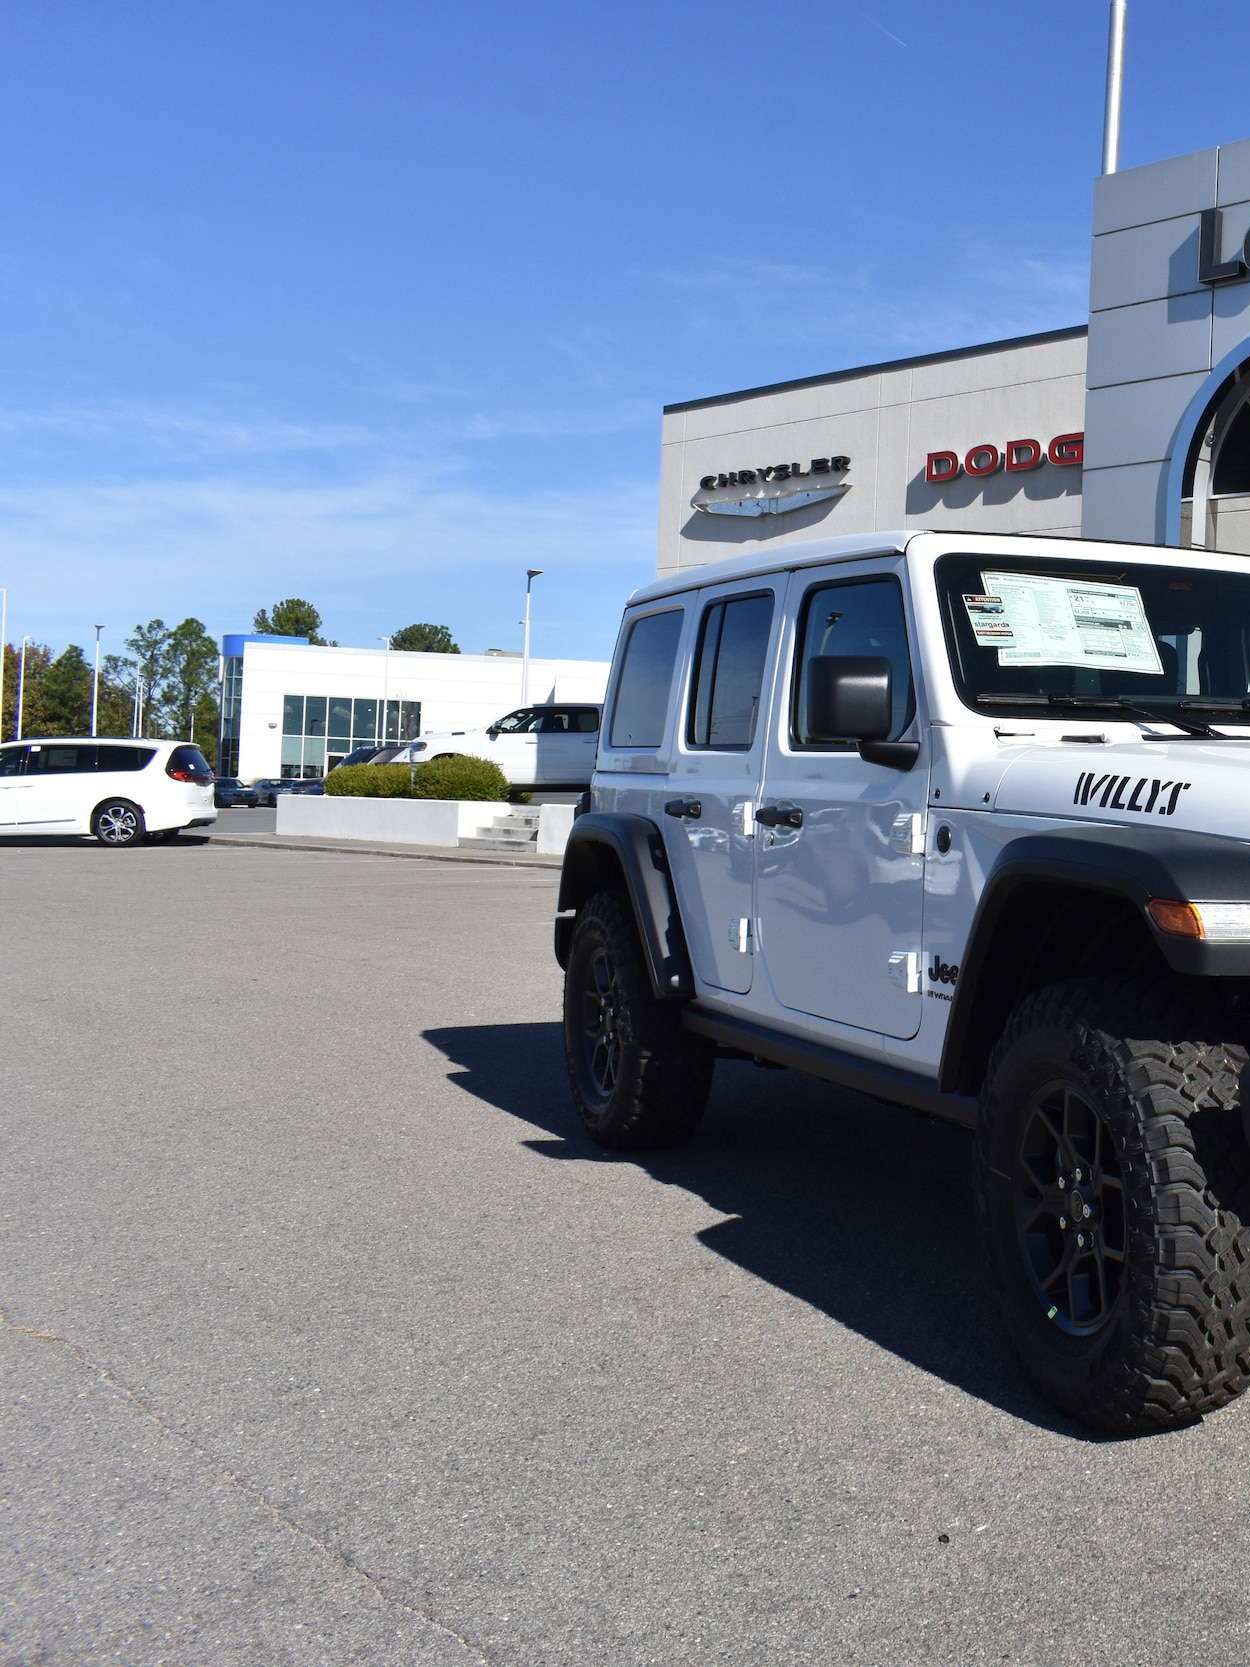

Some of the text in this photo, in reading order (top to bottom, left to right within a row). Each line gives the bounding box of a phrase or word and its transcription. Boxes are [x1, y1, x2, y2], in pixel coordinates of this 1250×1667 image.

[700, 455, 852, 490] CHRYSLER
[1073, 771, 1192, 816] WILLYS
[928, 955, 960, 986] Jee
